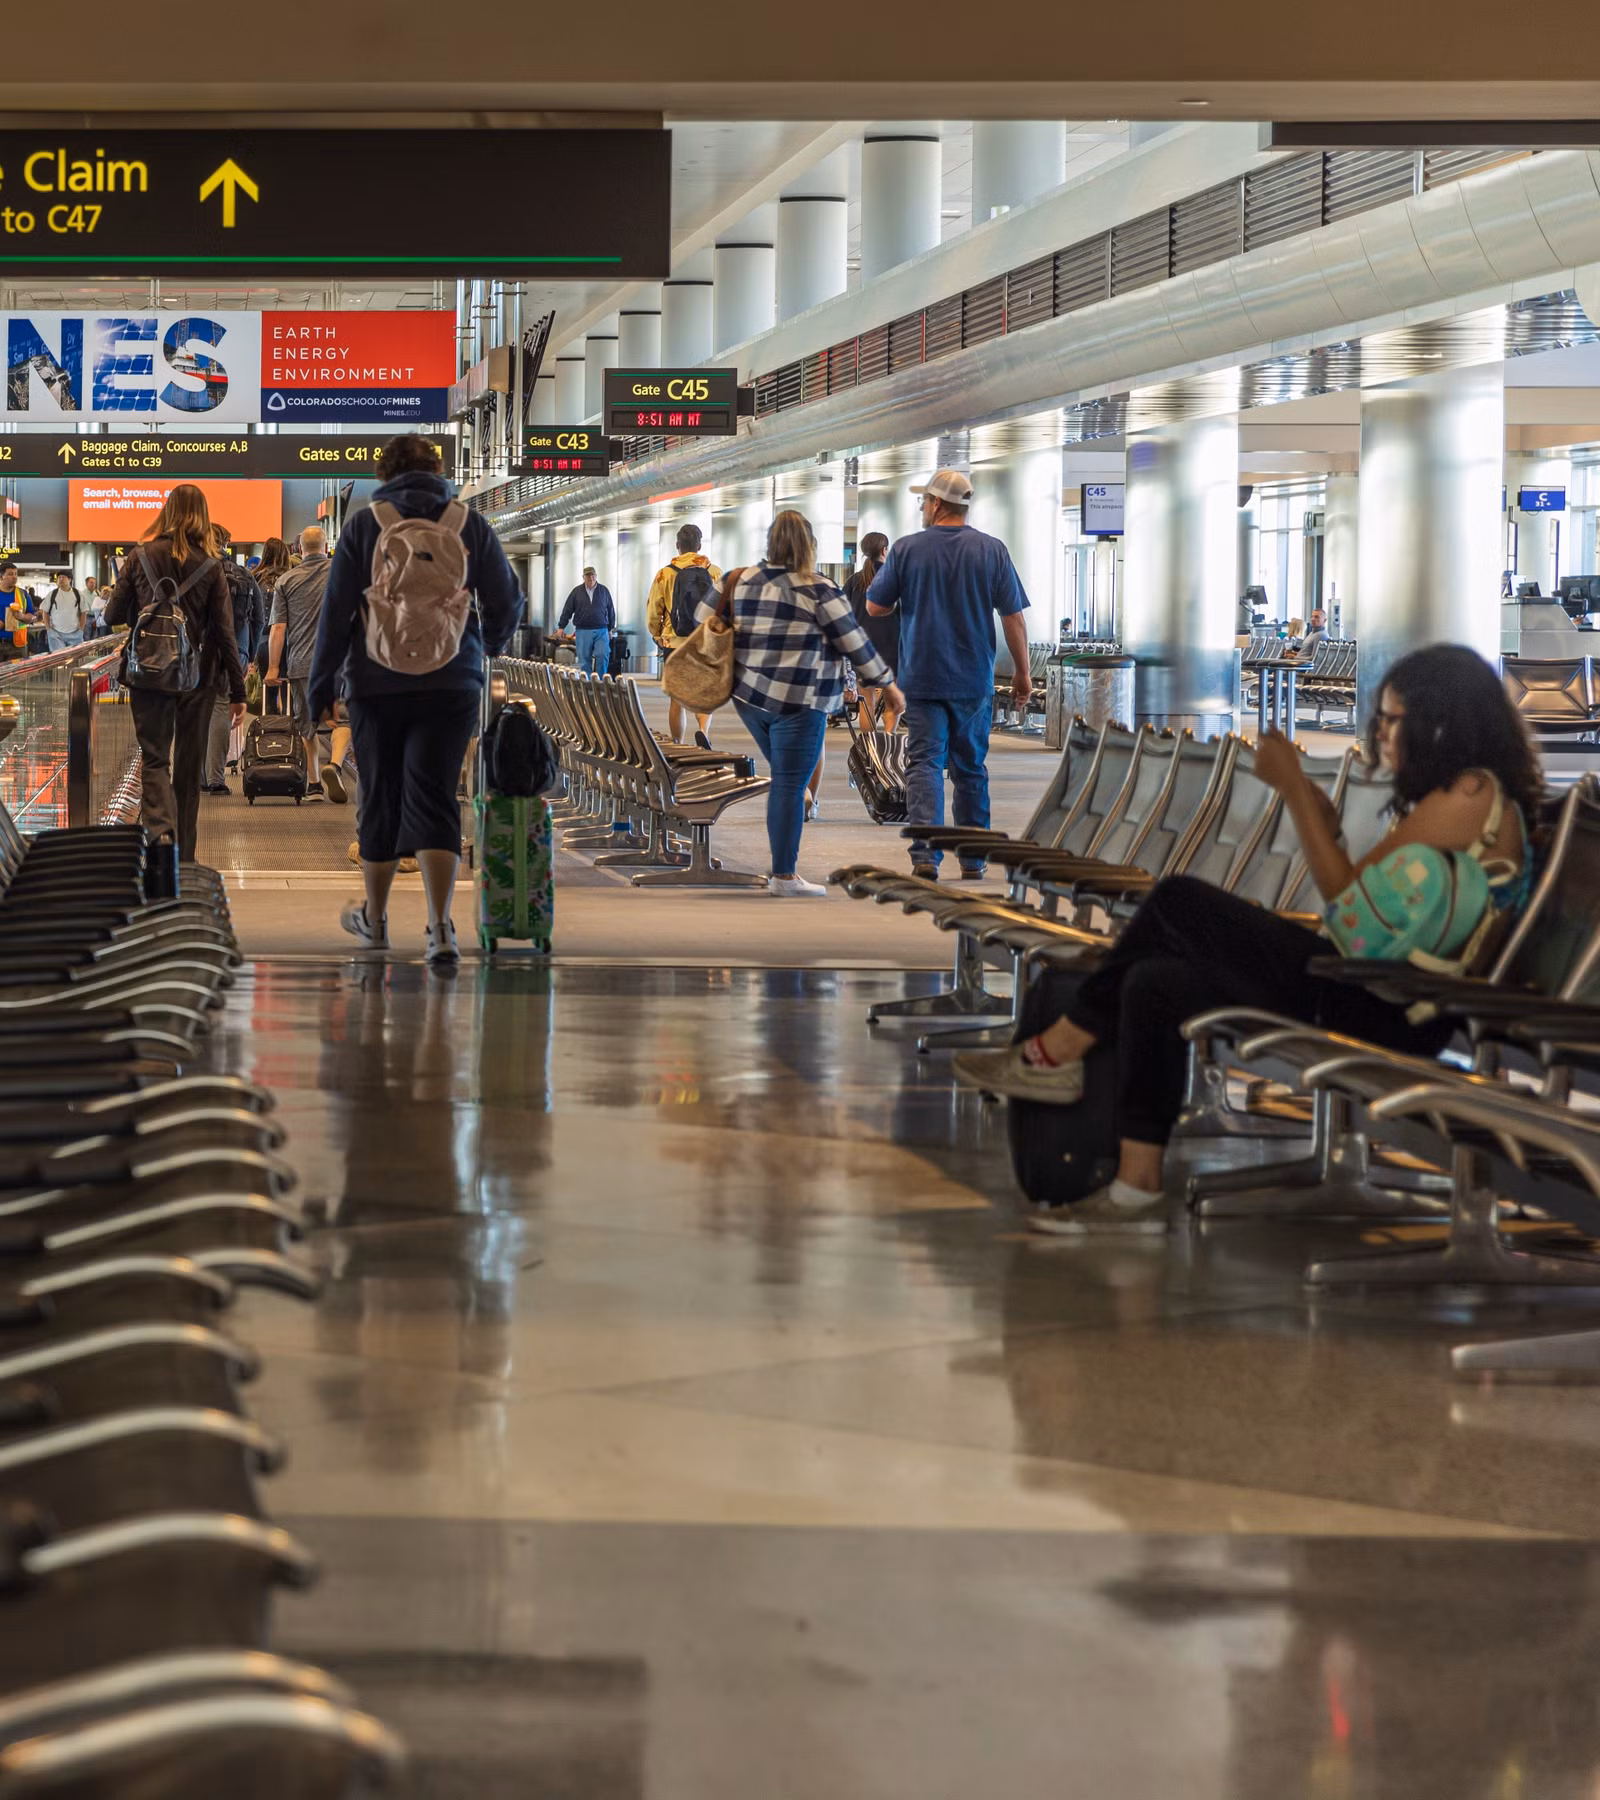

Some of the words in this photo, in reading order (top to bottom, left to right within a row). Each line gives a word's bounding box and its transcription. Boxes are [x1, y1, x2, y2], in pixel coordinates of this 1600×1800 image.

[23, 149, 148, 193] Claim
[3, 208, 35, 233] to
[47, 205, 102, 233] C47
[273, 327, 336, 339] EARTH
[273, 347, 349, 360] ENERGY
[273, 368, 414, 380] ENVIRONMENT
[632, 384, 661, 396] Gate
[667, 379, 709, 401] C45
[287, 397, 421, 406] COLORADOSCHOOLOFMINES
[637, 413, 663, 427] 8:51
[669, 413, 683, 427] AM
[687, 413, 702, 427] MT
[81, 440, 128, 454] Baggage
[131, 440, 163, 453] Claim,
[166, 440, 226, 453] Concourses
[229, 441, 248, 454] A,B
[529, 436, 552, 446] Gate
[556, 433, 589, 450] C43
[299, 447, 340, 461] Gates
[345, 448, 368, 461] C41
[81, 457, 111, 467] Gates
[113, 457, 125, 466] C1
[128, 458, 140, 466] to
[142, 457, 162, 467] C39
[533, 459, 553, 470] 8:51
[557, 459, 569, 470] AM
[83, 488, 120, 498] Search,
[122, 488, 162, 498] browse,
[1087, 487, 1106, 496] C45
[1539, 492, 1548, 501] C
[83, 500, 111, 509] email
[112, 500, 135, 509] with
[136, 501, 163, 509] more
